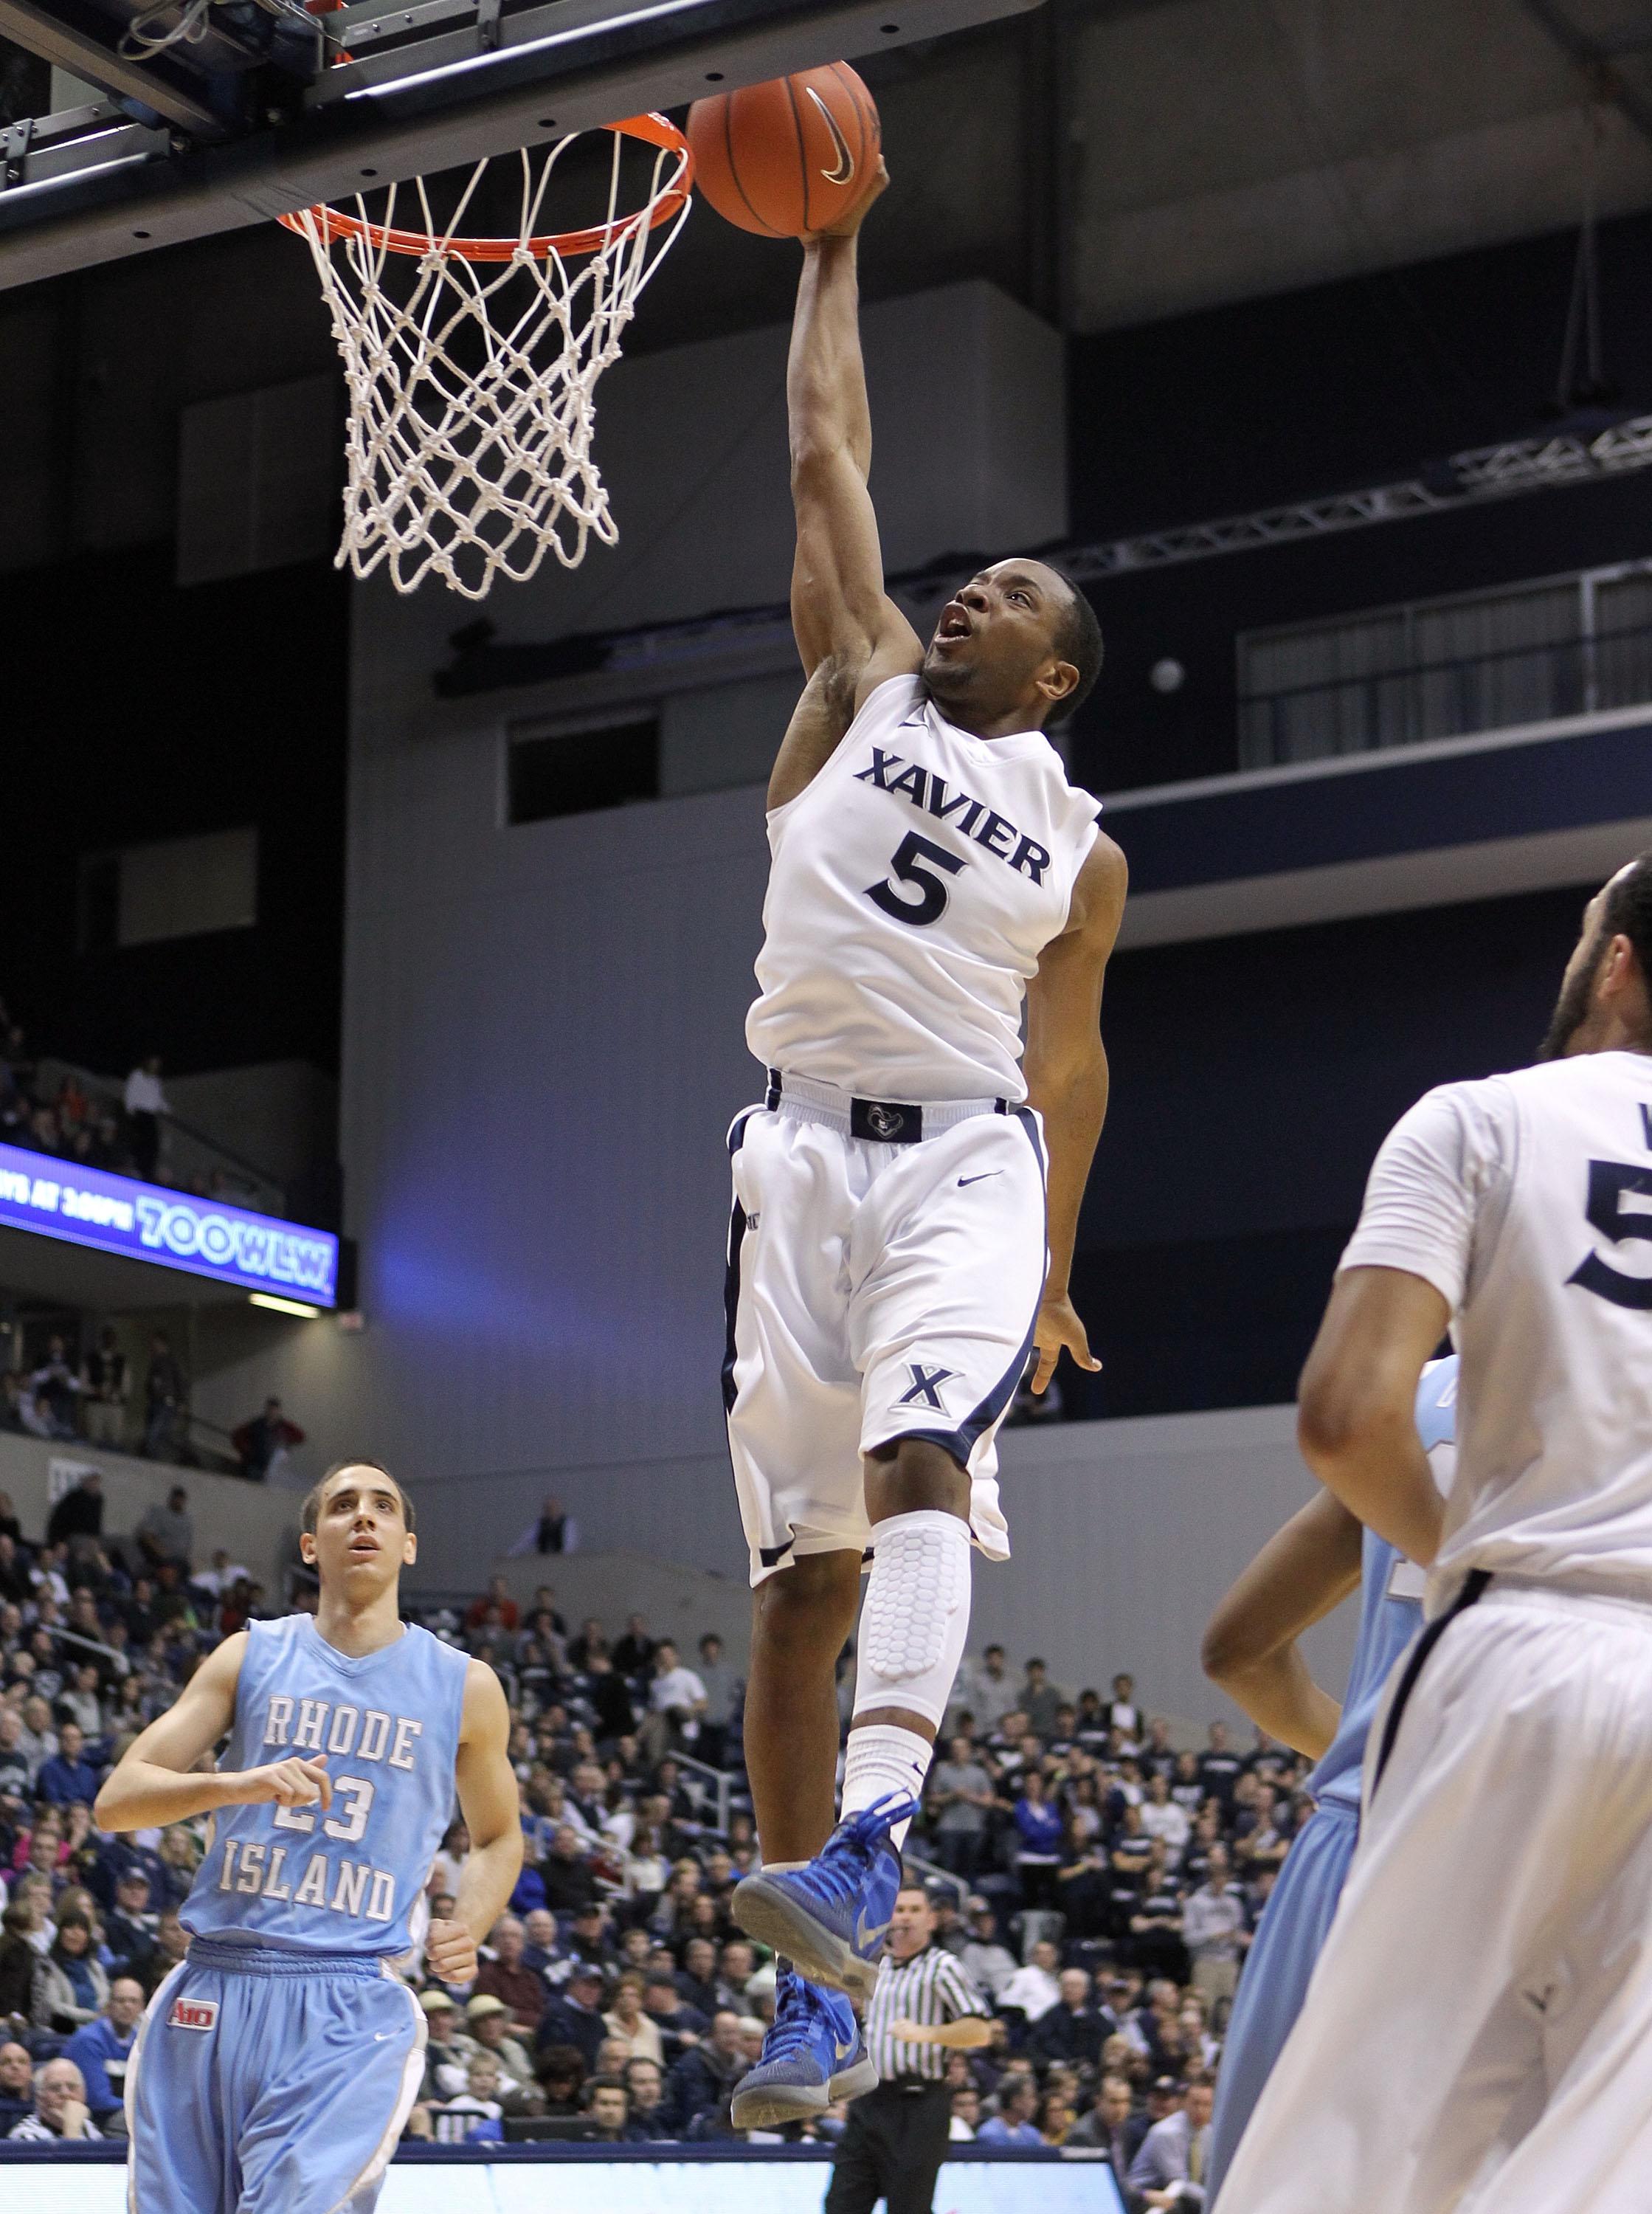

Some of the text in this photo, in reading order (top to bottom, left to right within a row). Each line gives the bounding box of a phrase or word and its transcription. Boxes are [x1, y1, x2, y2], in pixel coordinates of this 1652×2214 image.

[853, 746, 1052, 889] XAVIER
[862, 830, 970, 926] 5
[888, 1362, 964, 1416] X
[263, 1694, 423, 1772] RHODE
[218, 1840, 396, 1923] ISLAND
